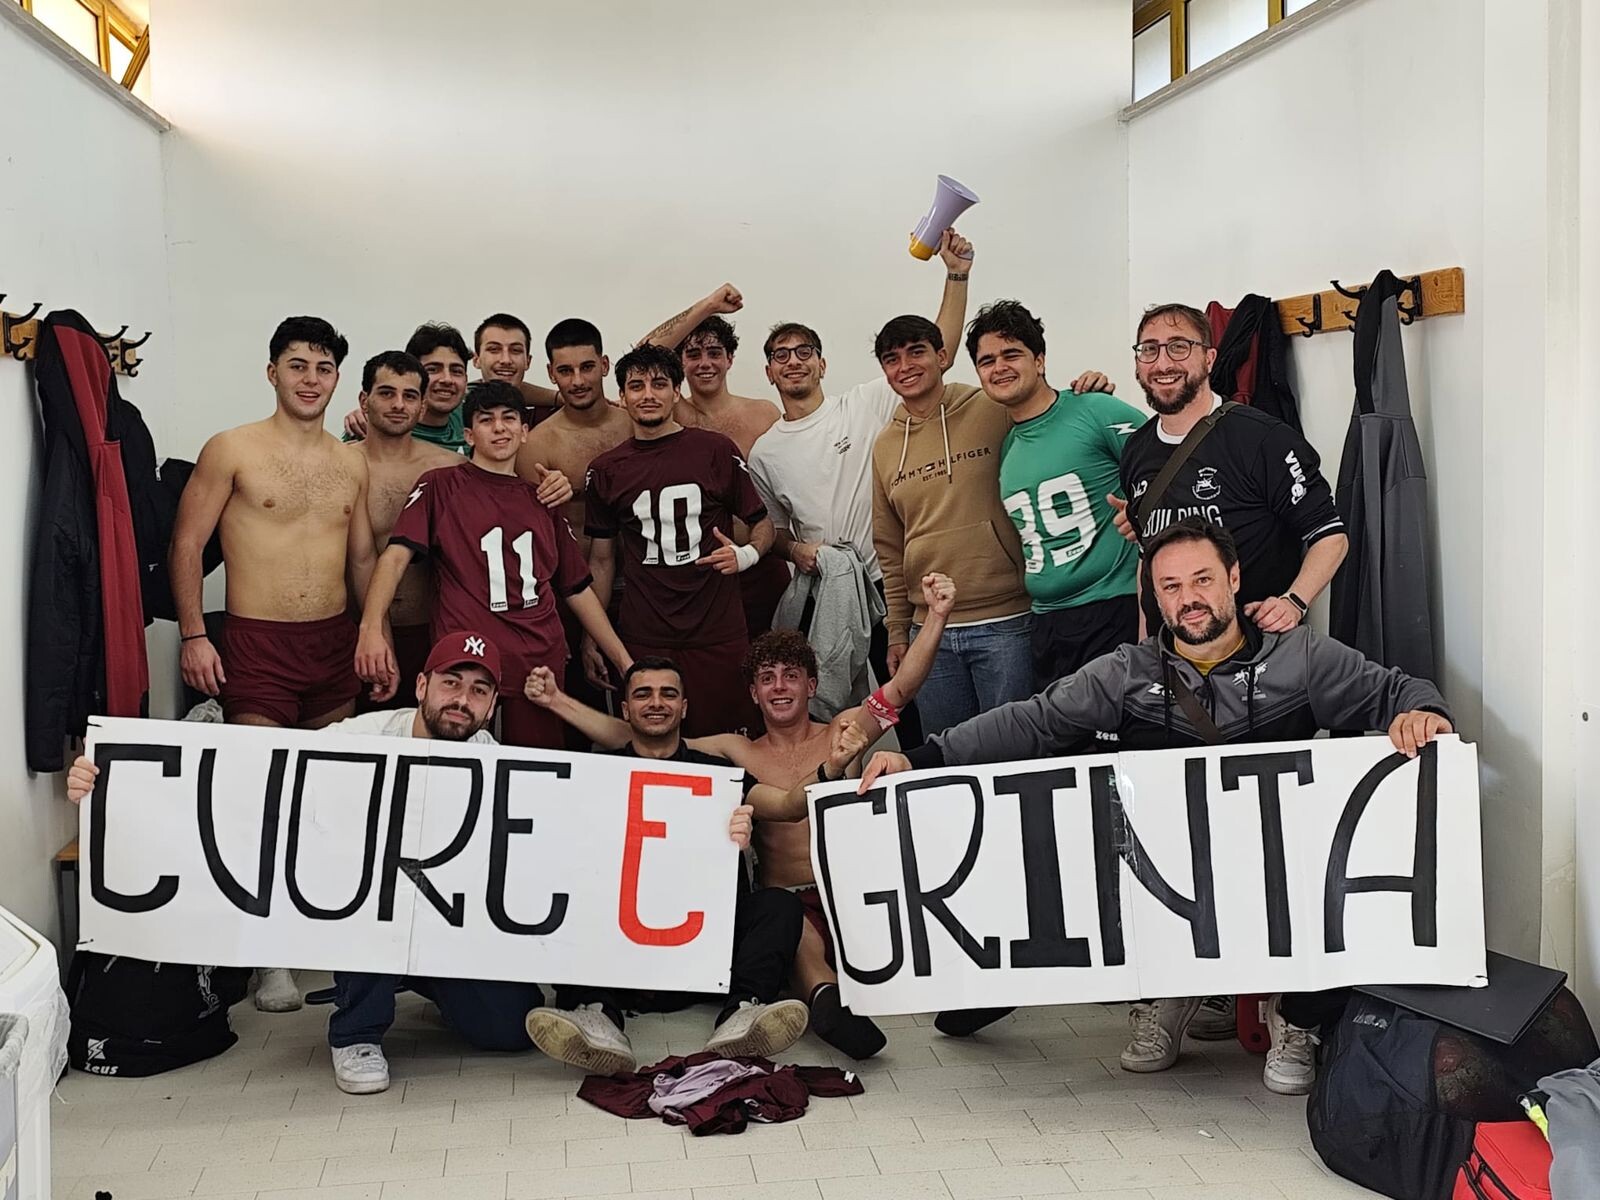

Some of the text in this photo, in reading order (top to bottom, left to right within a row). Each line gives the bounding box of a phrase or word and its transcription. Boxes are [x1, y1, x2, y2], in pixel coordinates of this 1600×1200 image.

[938, 447, 992, 468] HLFIGER
[632, 483, 702, 567] 10
[1003, 472, 1098, 574] 89
[480, 526, 539, 612] 11
[463, 635, 486, 657] NY
[618, 771, 712, 946] E
[814, 740, 1438, 985] GRINTA
[84, 1061, 119, 1075] Zeus
